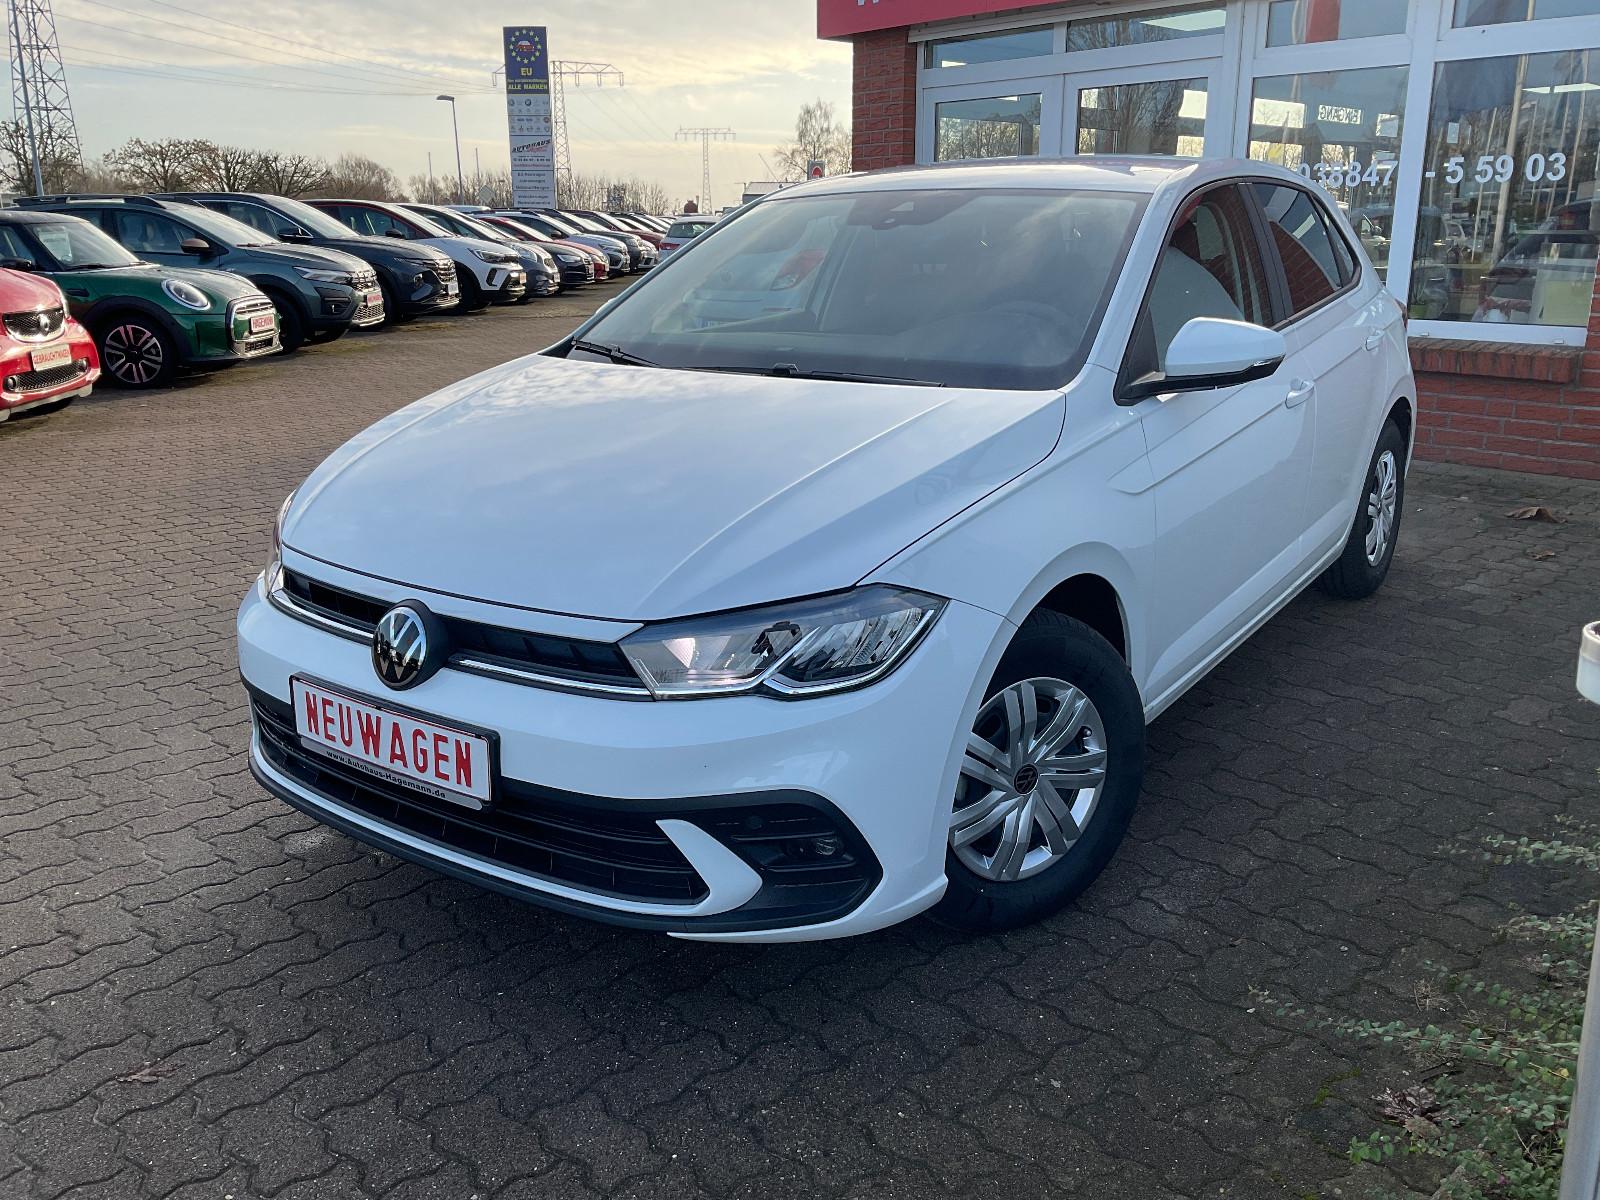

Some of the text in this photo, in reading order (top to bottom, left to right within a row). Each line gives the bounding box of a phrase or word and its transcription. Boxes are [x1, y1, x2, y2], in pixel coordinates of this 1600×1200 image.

[520, 67, 533, 76] EU
[512, 138, 551, 153] AUTOHAUS
[1445, 155, 1465, 184] 5
[1475, 154, 1514, 184] 59
[1525, 152, 1567, 183] 03
[304, 690, 473, 788] NEUWAGEN
[326, 750, 447, 799] www.Autohaus-Hagemann.de
